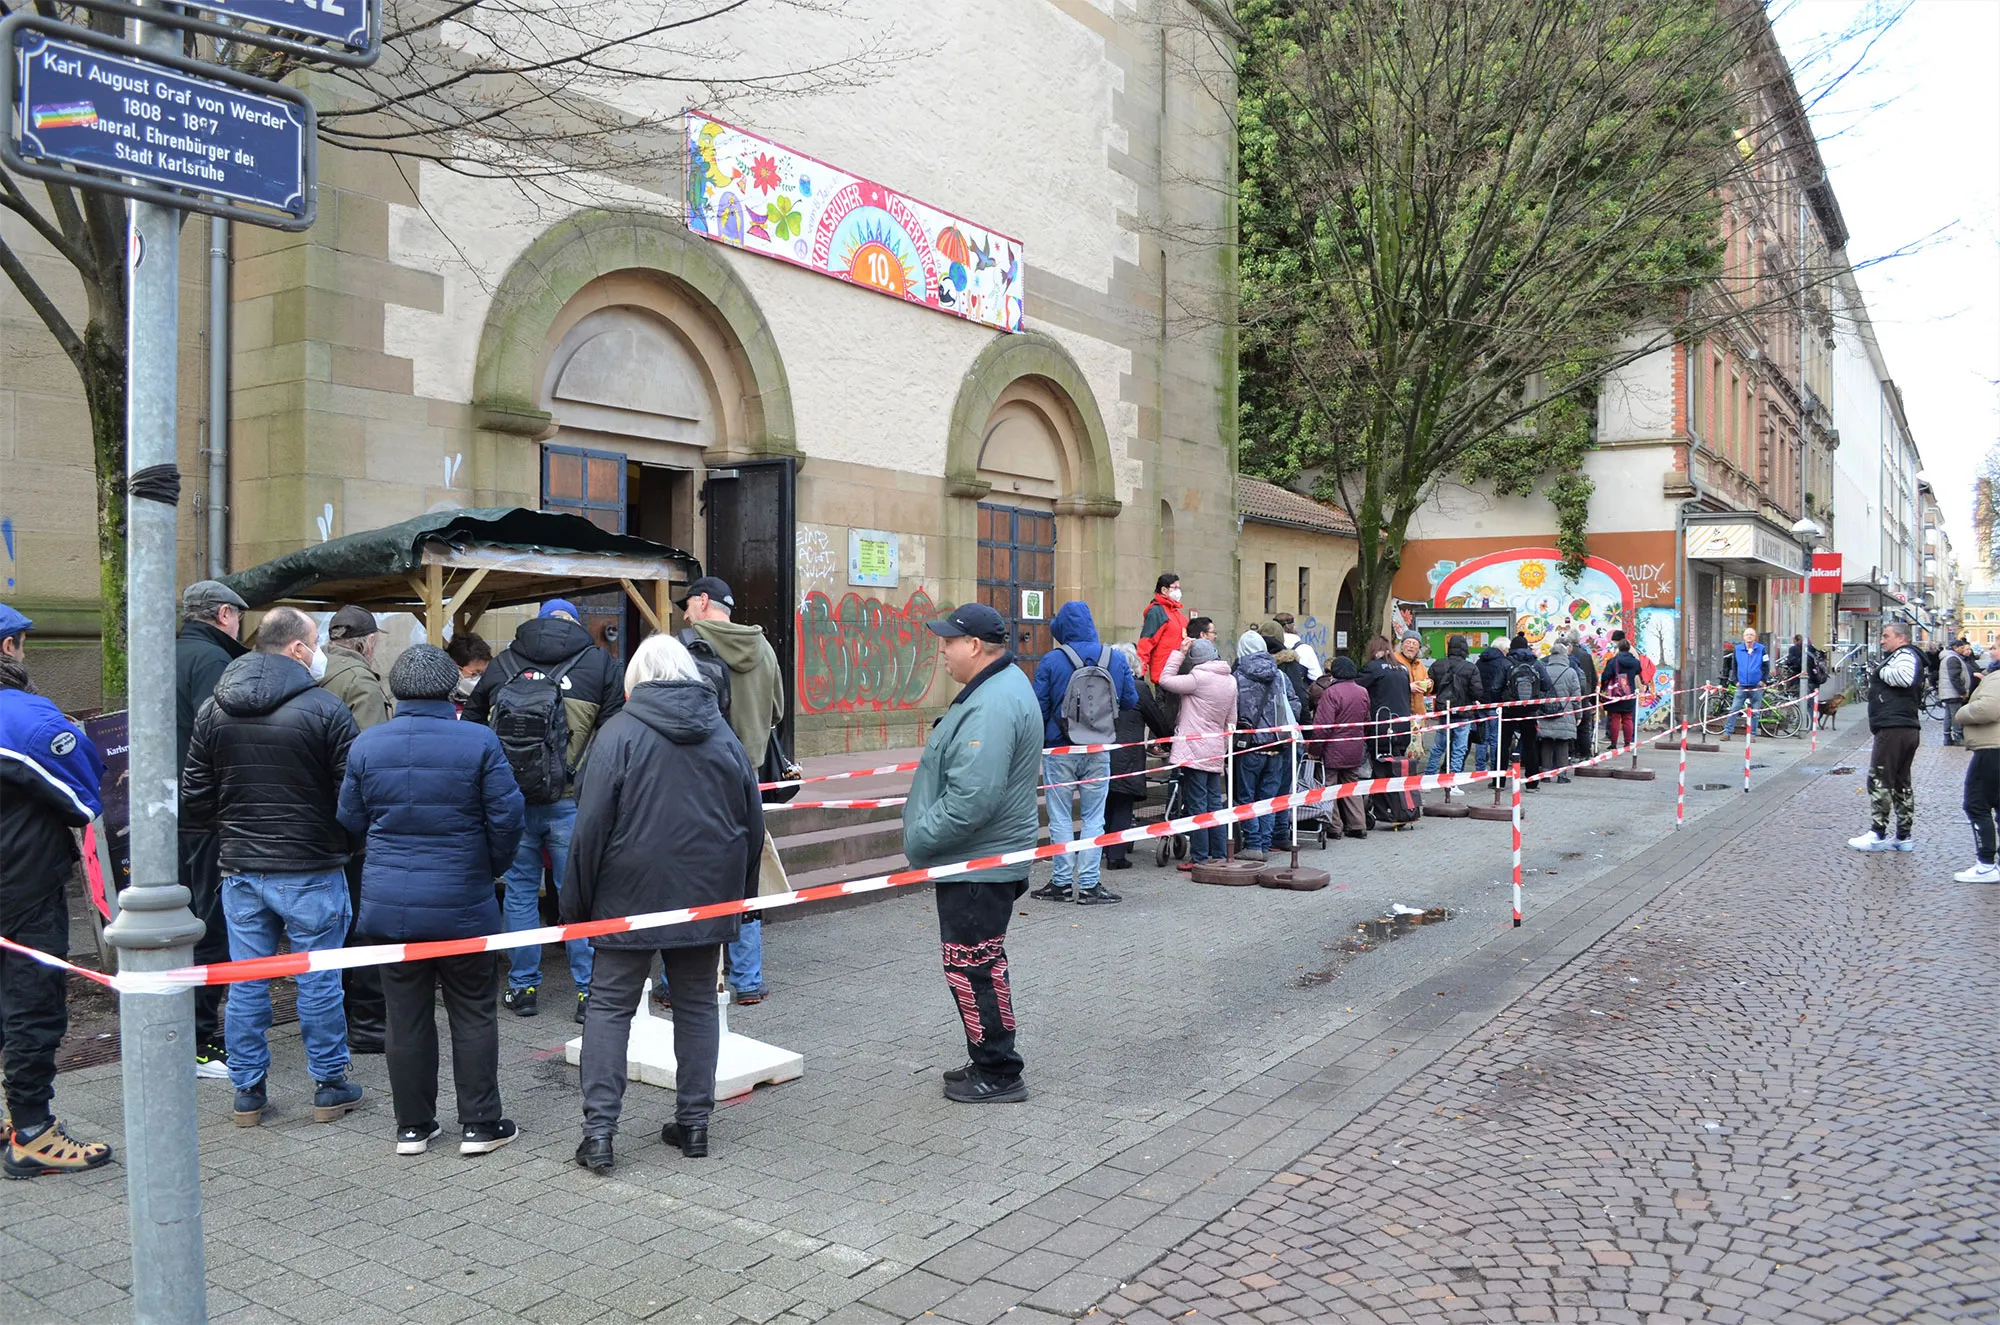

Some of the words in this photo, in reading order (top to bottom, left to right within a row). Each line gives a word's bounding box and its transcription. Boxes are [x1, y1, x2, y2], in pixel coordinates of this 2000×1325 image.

[44, 52, 82, 78] Karl
[88, 66, 149, 96] August
[156, 82, 192, 105] Graf
[197, 97, 225, 116] von
[230, 101, 287, 131] Werder
[123, 97, 161, 122] 1808
[81, 117, 141, 141] eneral,
[146, 126, 231, 163] Ehrenbürger
[115, 142, 154, 166] Stadt
[158, 154, 226, 182] Karlsruhe
[812, 184, 865, 269] KARLSRUHER
[884, 190, 939, 300] VESPERKIRCHE
[868, 252, 896, 291] 10.
[1810, 567, 1841, 577] hkauf
[106, 745, 129, 756] Karlsr
